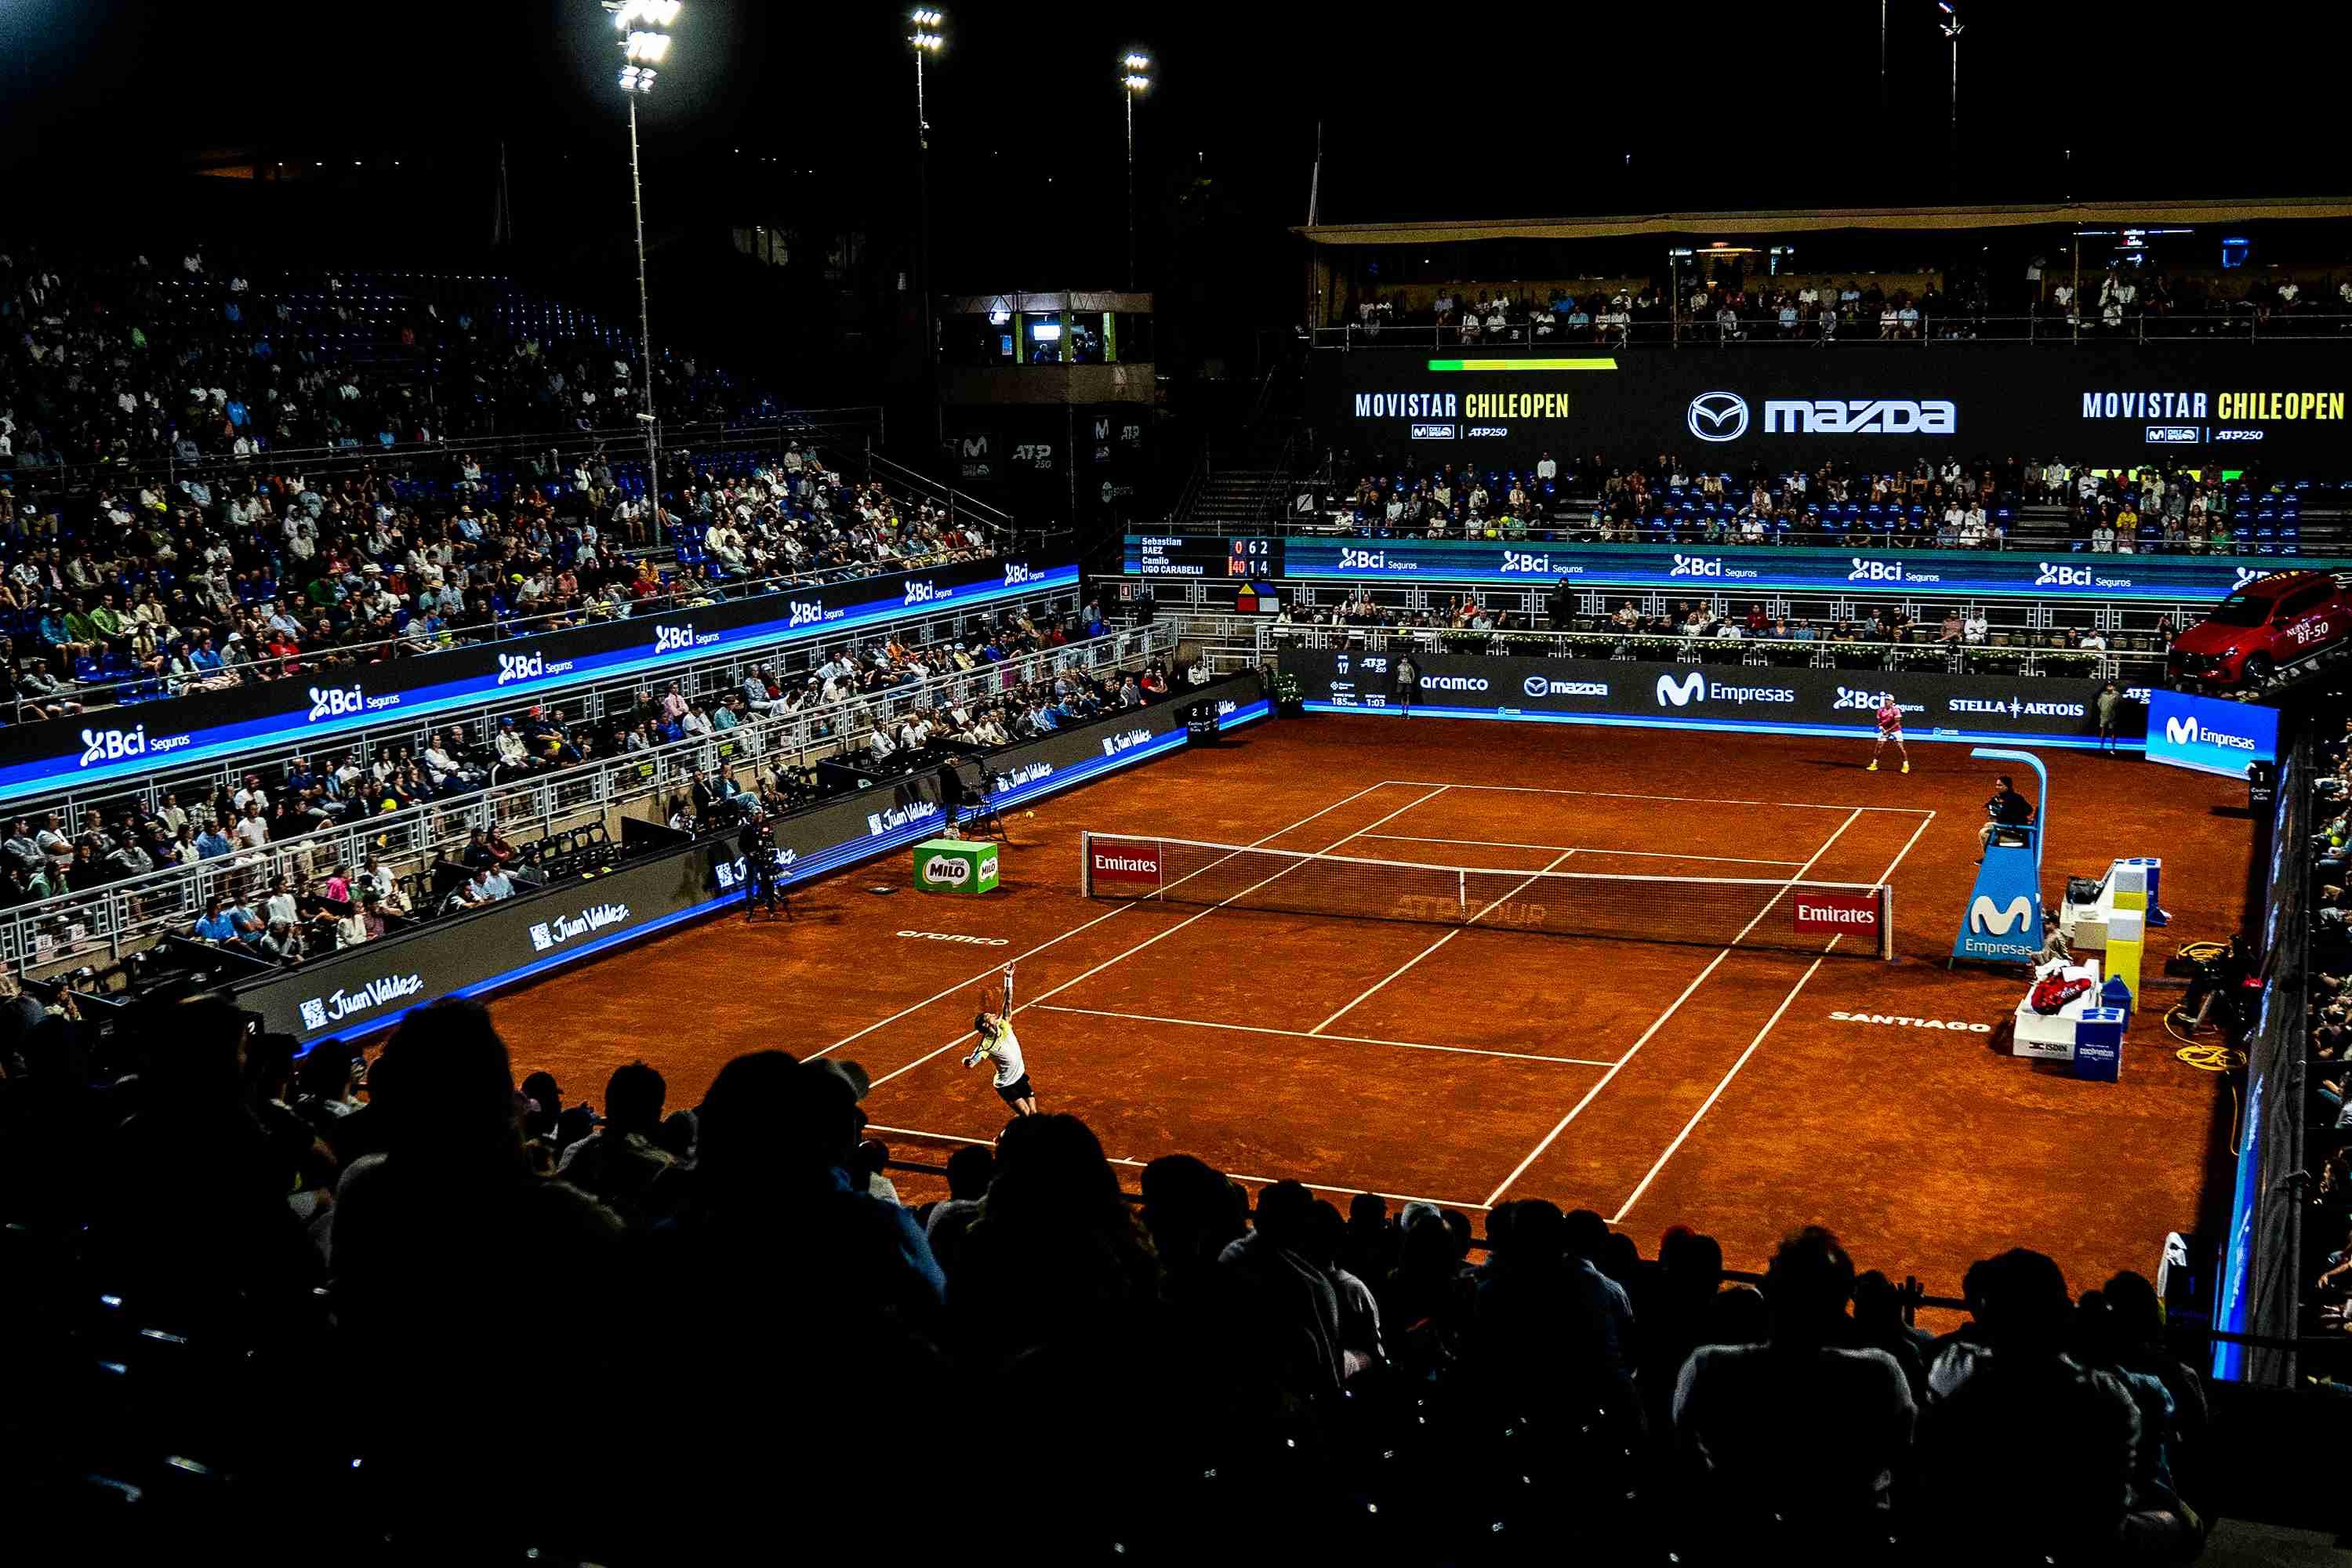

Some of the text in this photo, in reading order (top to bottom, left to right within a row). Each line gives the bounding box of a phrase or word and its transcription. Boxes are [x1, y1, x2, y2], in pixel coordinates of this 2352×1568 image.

[1356, 394, 1455, 416] MOVISTAR
[2083, 393, 2205, 417] MOVISTAR
[1142, 537, 1181, 546] Sebastian
[1142, 546, 1163, 555] BAEZ
[1236, 541, 1267, 554] 0 6 2
[1232, 561, 1267, 573] 40 1 4
[1357, 551, 1417, 571] Bci Seguros
[1521, 554, 1583, 574] Bci Seguros
[1690, 558, 1756, 578] Bci Seguros
[1014, 564, 1044, 583] Bci Seguros
[1867, 561, 1939, 582] Bci Seguros
[2056, 567, 2131, 587] Bci Seguros
[917, 580, 952, 601] Bci Seguros
[804, 601, 844, 622] Bci Seguros
[671, 623, 719, 648] Bci Seguros
[2298, 622, 2328, 644] BT-50
[515, 652, 572, 677] Bci Seguros
[1338, 662, 1348, 673] 17
[1421, 677, 1488, 690] aramco
[1711, 683, 1794, 704] Empresas
[331, 684, 400, 715] Bci Seguros
[1331, 697, 1348, 706] 185
[1366, 699, 1385, 707] 1:03
[1855, 691, 1885, 710] Bci
[1949, 699, 2083, 716] STELLA ARTOIS
[107, 724, 190, 757] Bci Seguros
[1114, 733, 1131, 753] Juan
[2201, 728, 2254, 750] Empresas
[1009, 765, 1029, 788] Juan
[883, 808, 908, 831] Juan
[930, 863, 964, 878] MILO
[982, 863, 995, 877] MILO
[1095, 855, 1156, 872] Emirates
[1798, 905, 1874, 923] Emirates
[552, 915, 589, 943] Juan
[896, 930, 1010, 946] aramco
[1965, 938, 2033, 956] Empresas
[328, 989, 372, 1020] Juan
[1828, 1011, 1991, 1033] SANTIAGO
